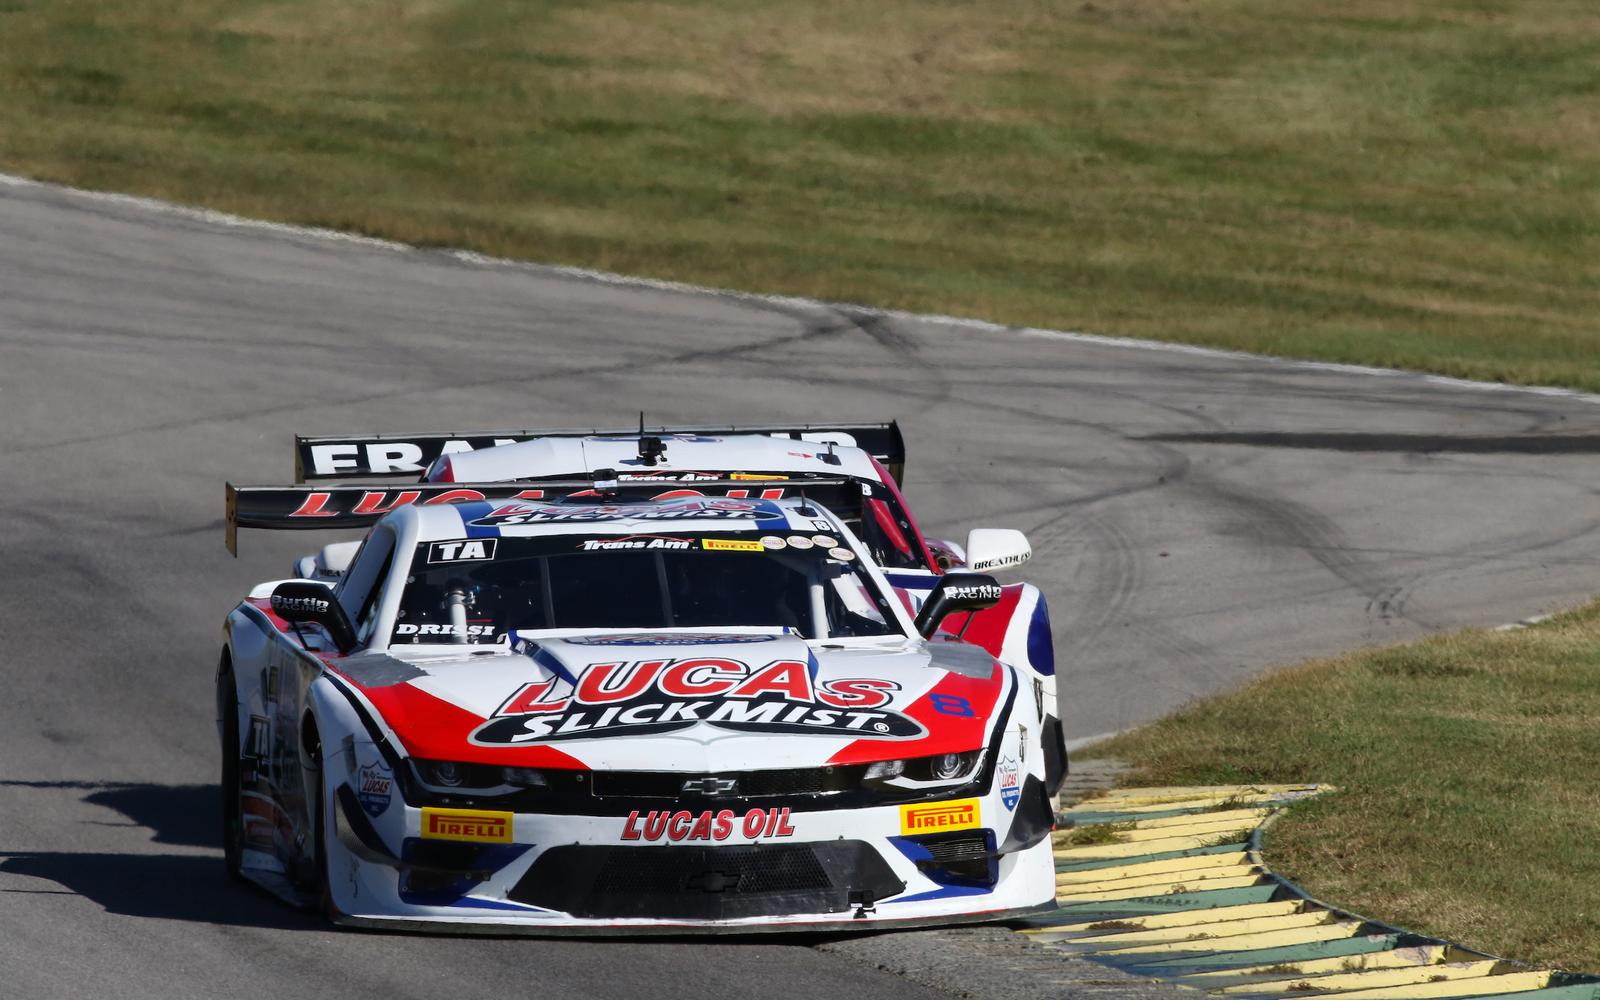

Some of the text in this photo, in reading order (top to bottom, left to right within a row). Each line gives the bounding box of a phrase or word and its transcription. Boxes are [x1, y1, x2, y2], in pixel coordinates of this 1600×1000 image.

[438, 541, 486, 561] TA
[583, 538, 690, 550] Trans Am
[491, 657, 901, 717] LUCAS
[929, 693, 975, 718] 8
[362, 780, 391, 794] LUCAS
[429, 813, 506, 837] PIRELLI
[619, 807, 796, 842] LUCAS OIL
[907, 804, 974, 829] PIRELLI
